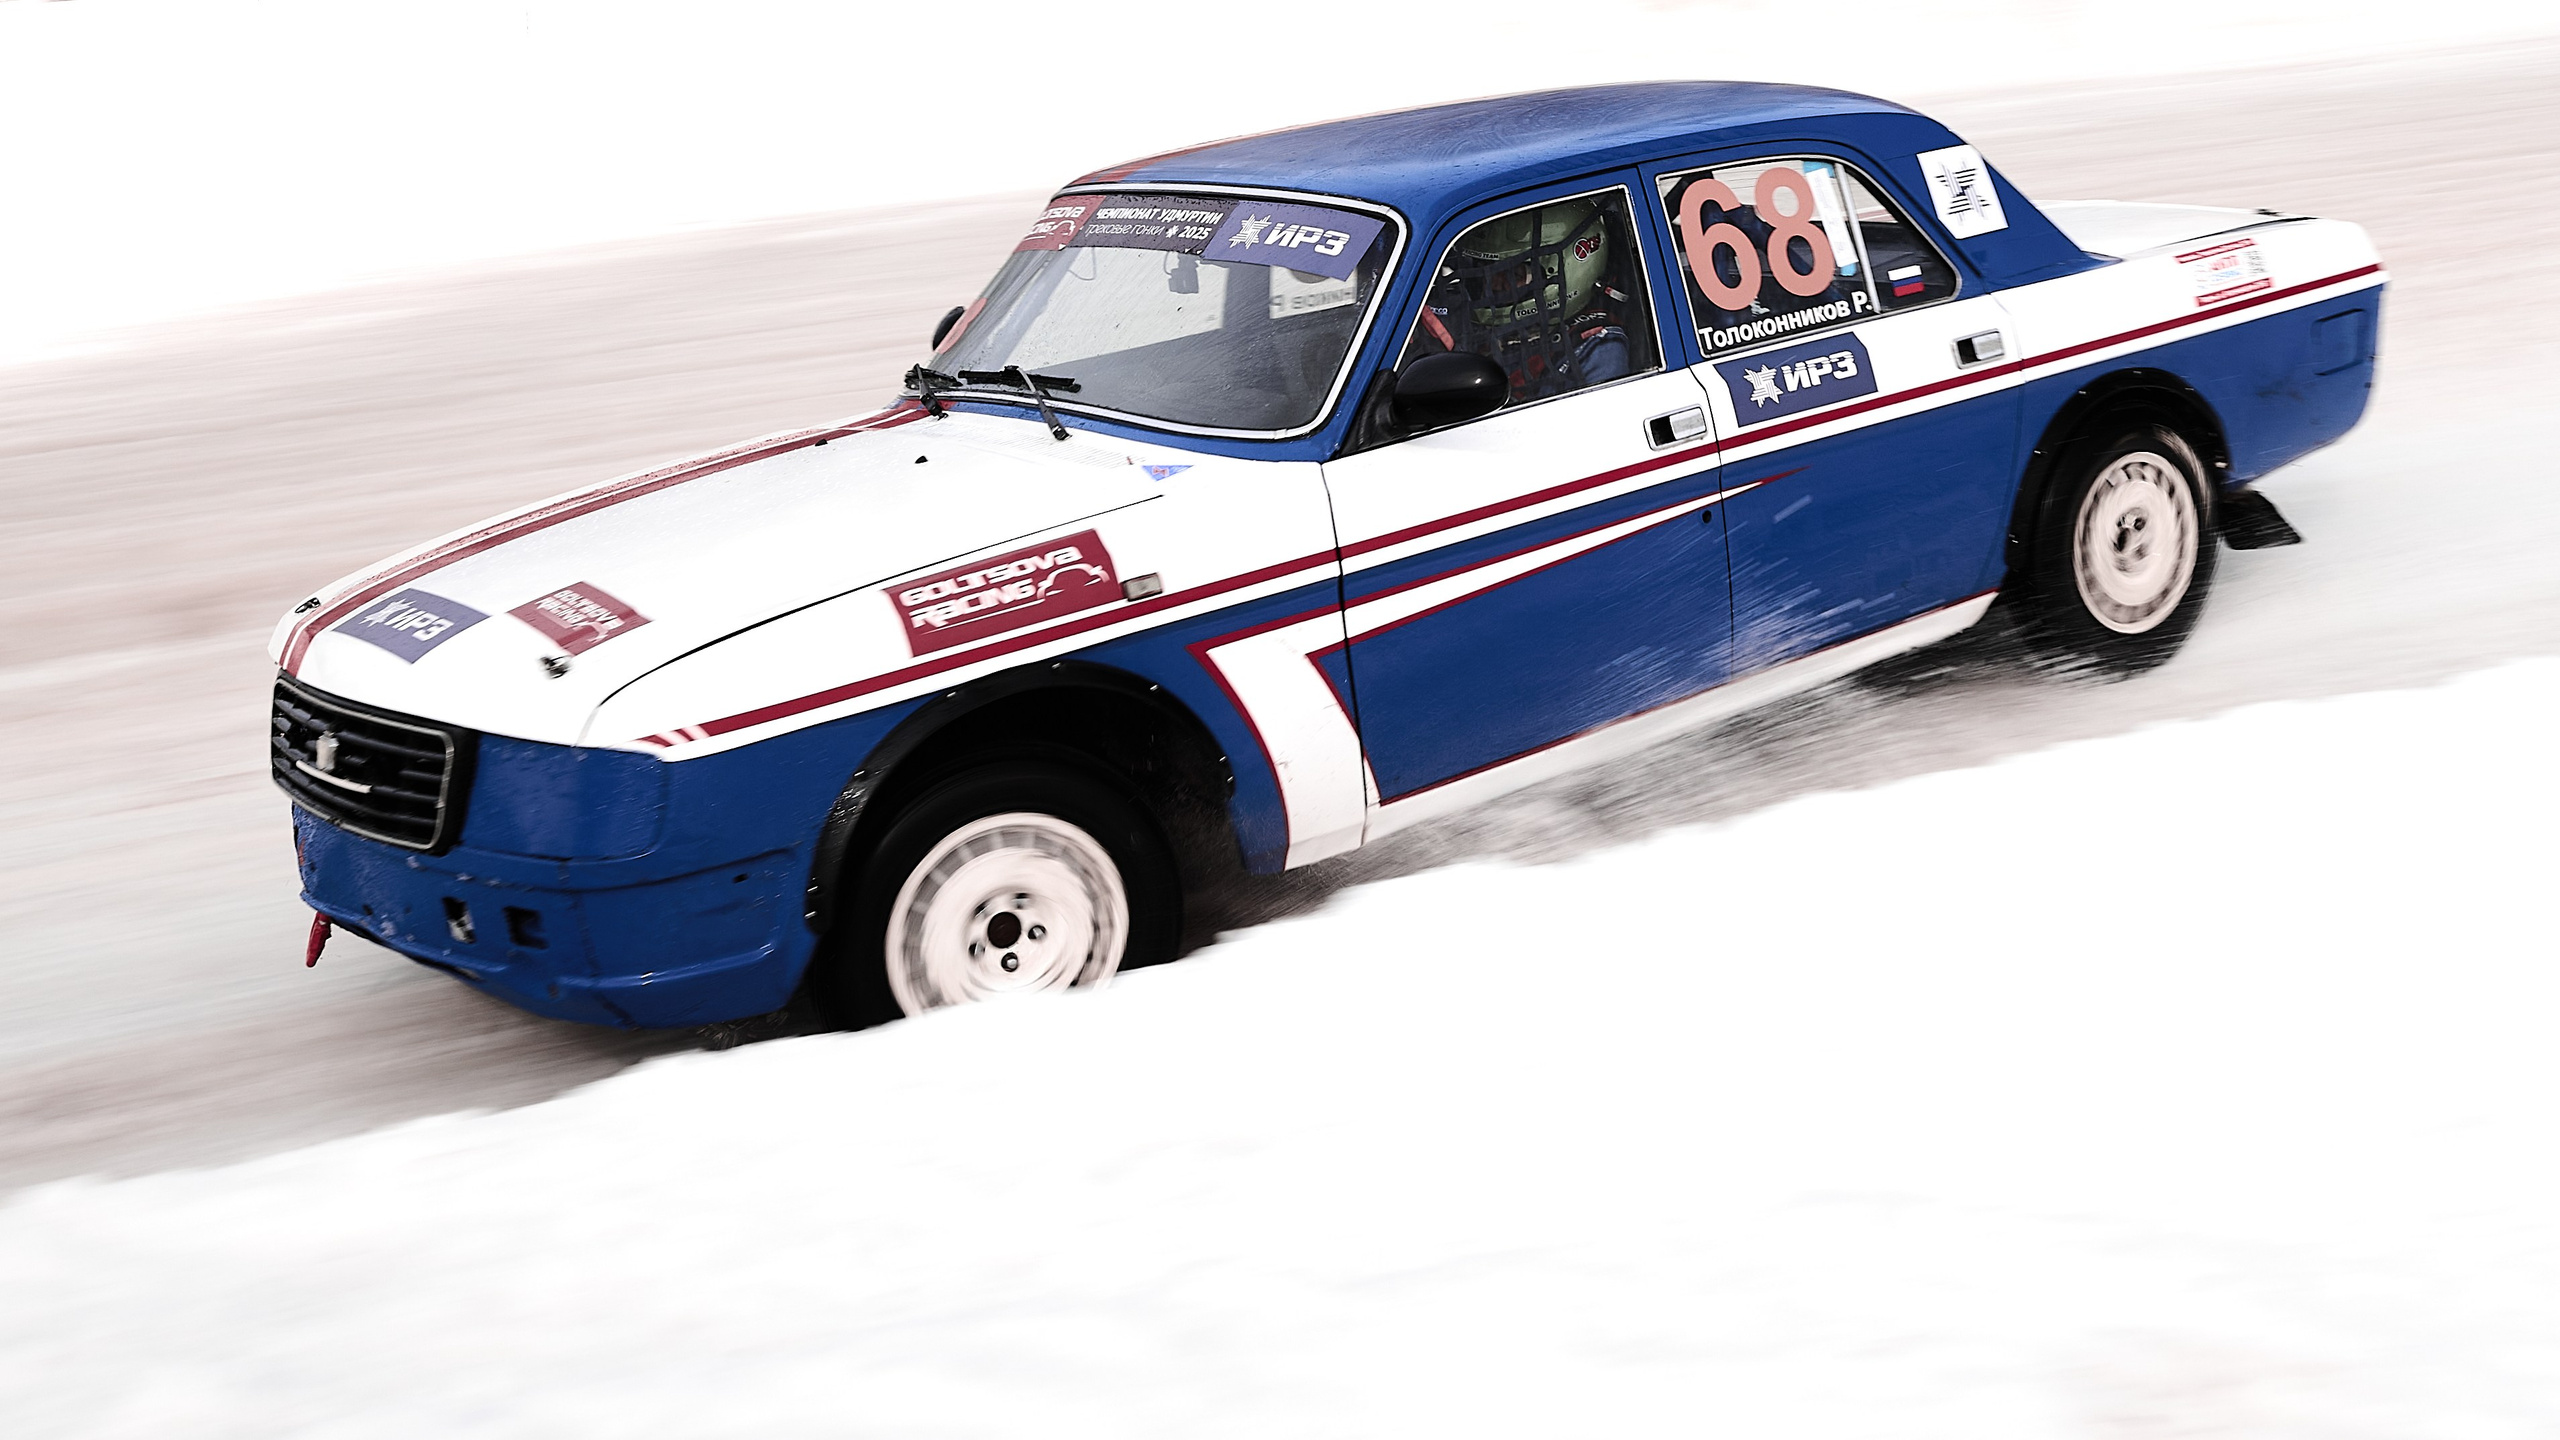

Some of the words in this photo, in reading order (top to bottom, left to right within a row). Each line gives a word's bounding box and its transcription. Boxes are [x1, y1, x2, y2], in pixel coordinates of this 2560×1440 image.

[1096, 207, 1161, 220] ЧЕМПИОНАТ
[1157, 208, 1224, 225] УДМУРТИИ
[1132, 225, 1166, 235] гонки
[1177, 226, 1212, 240] 2025
[1264, 223, 1350, 256] ИРЗ
[1679, 166, 1835, 311] 68
[1699, 300, 1851, 351] Толоконников
[1851, 291, 1873, 314] Р.
[1781, 351, 1858, 393] ИРЗ
[386, 605, 455, 642] ИРЗ
